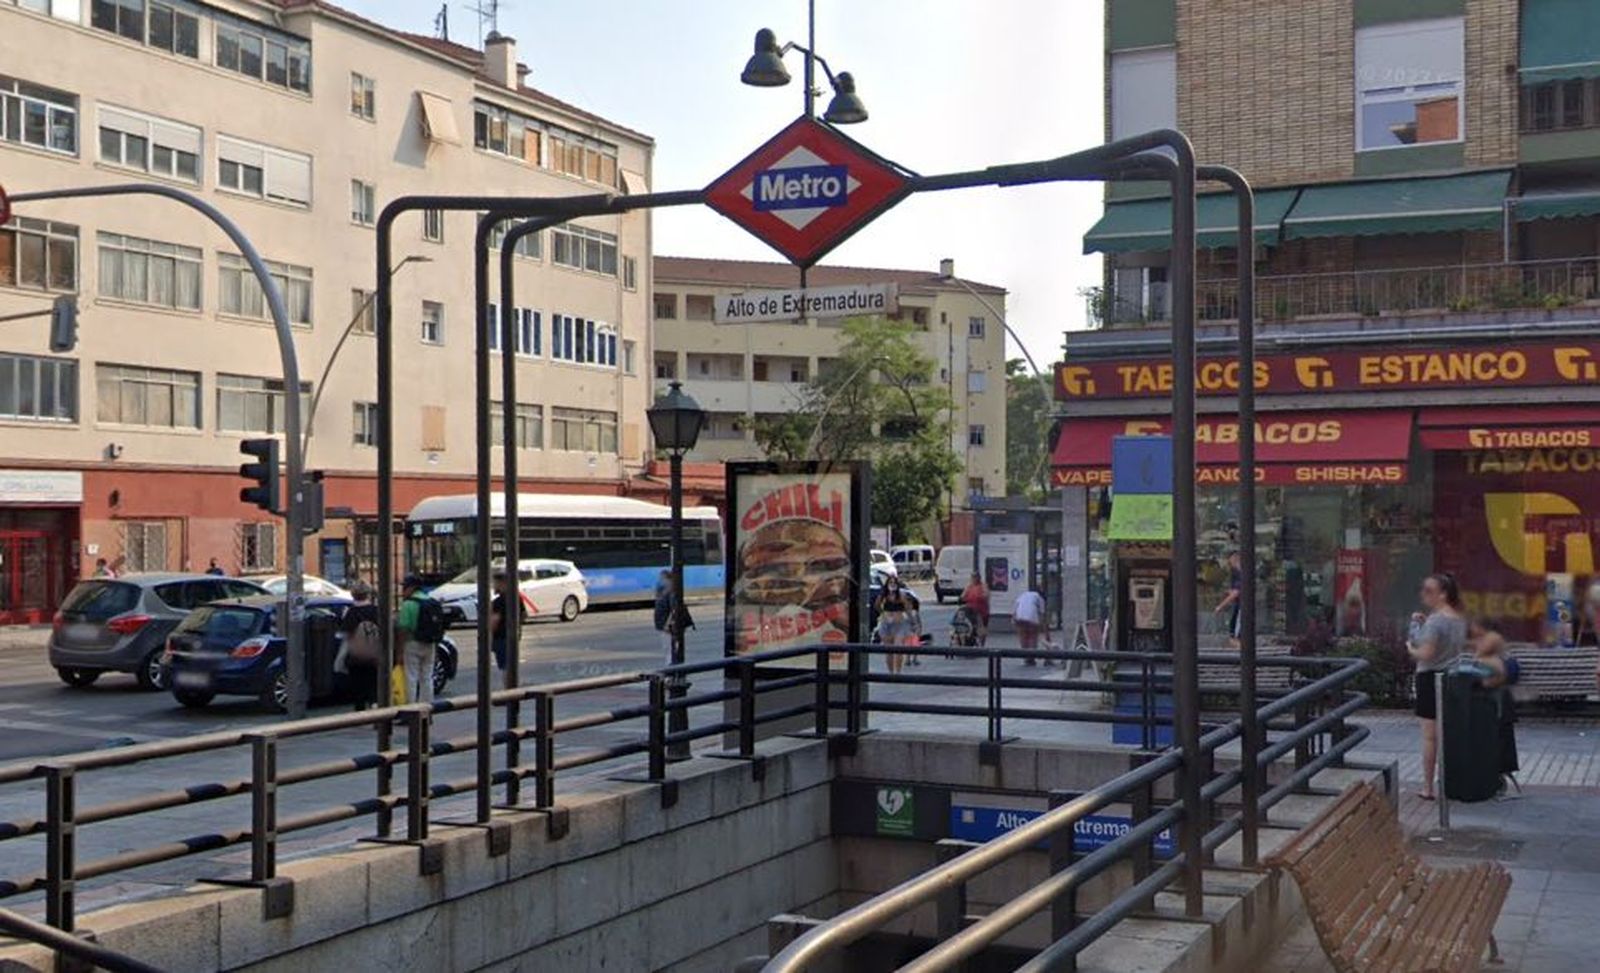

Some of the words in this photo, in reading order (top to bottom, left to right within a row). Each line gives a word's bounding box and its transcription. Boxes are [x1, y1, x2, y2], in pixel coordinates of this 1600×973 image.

[760, 174, 841, 201] Metro
[726, 298, 755, 317] Alto
[758, 296, 778, 314] de
[783, 291, 884, 316] Extremadura
[1117, 361, 1270, 393] TABCOS
[1360, 351, 1527, 384] ESTANCO
[1496, 430, 1591, 448] TABACOS
[1296, 466, 1401, 482] SHISHAS
[741, 481, 844, 531] CHILI
[996, 812, 1027, 829] Alto
